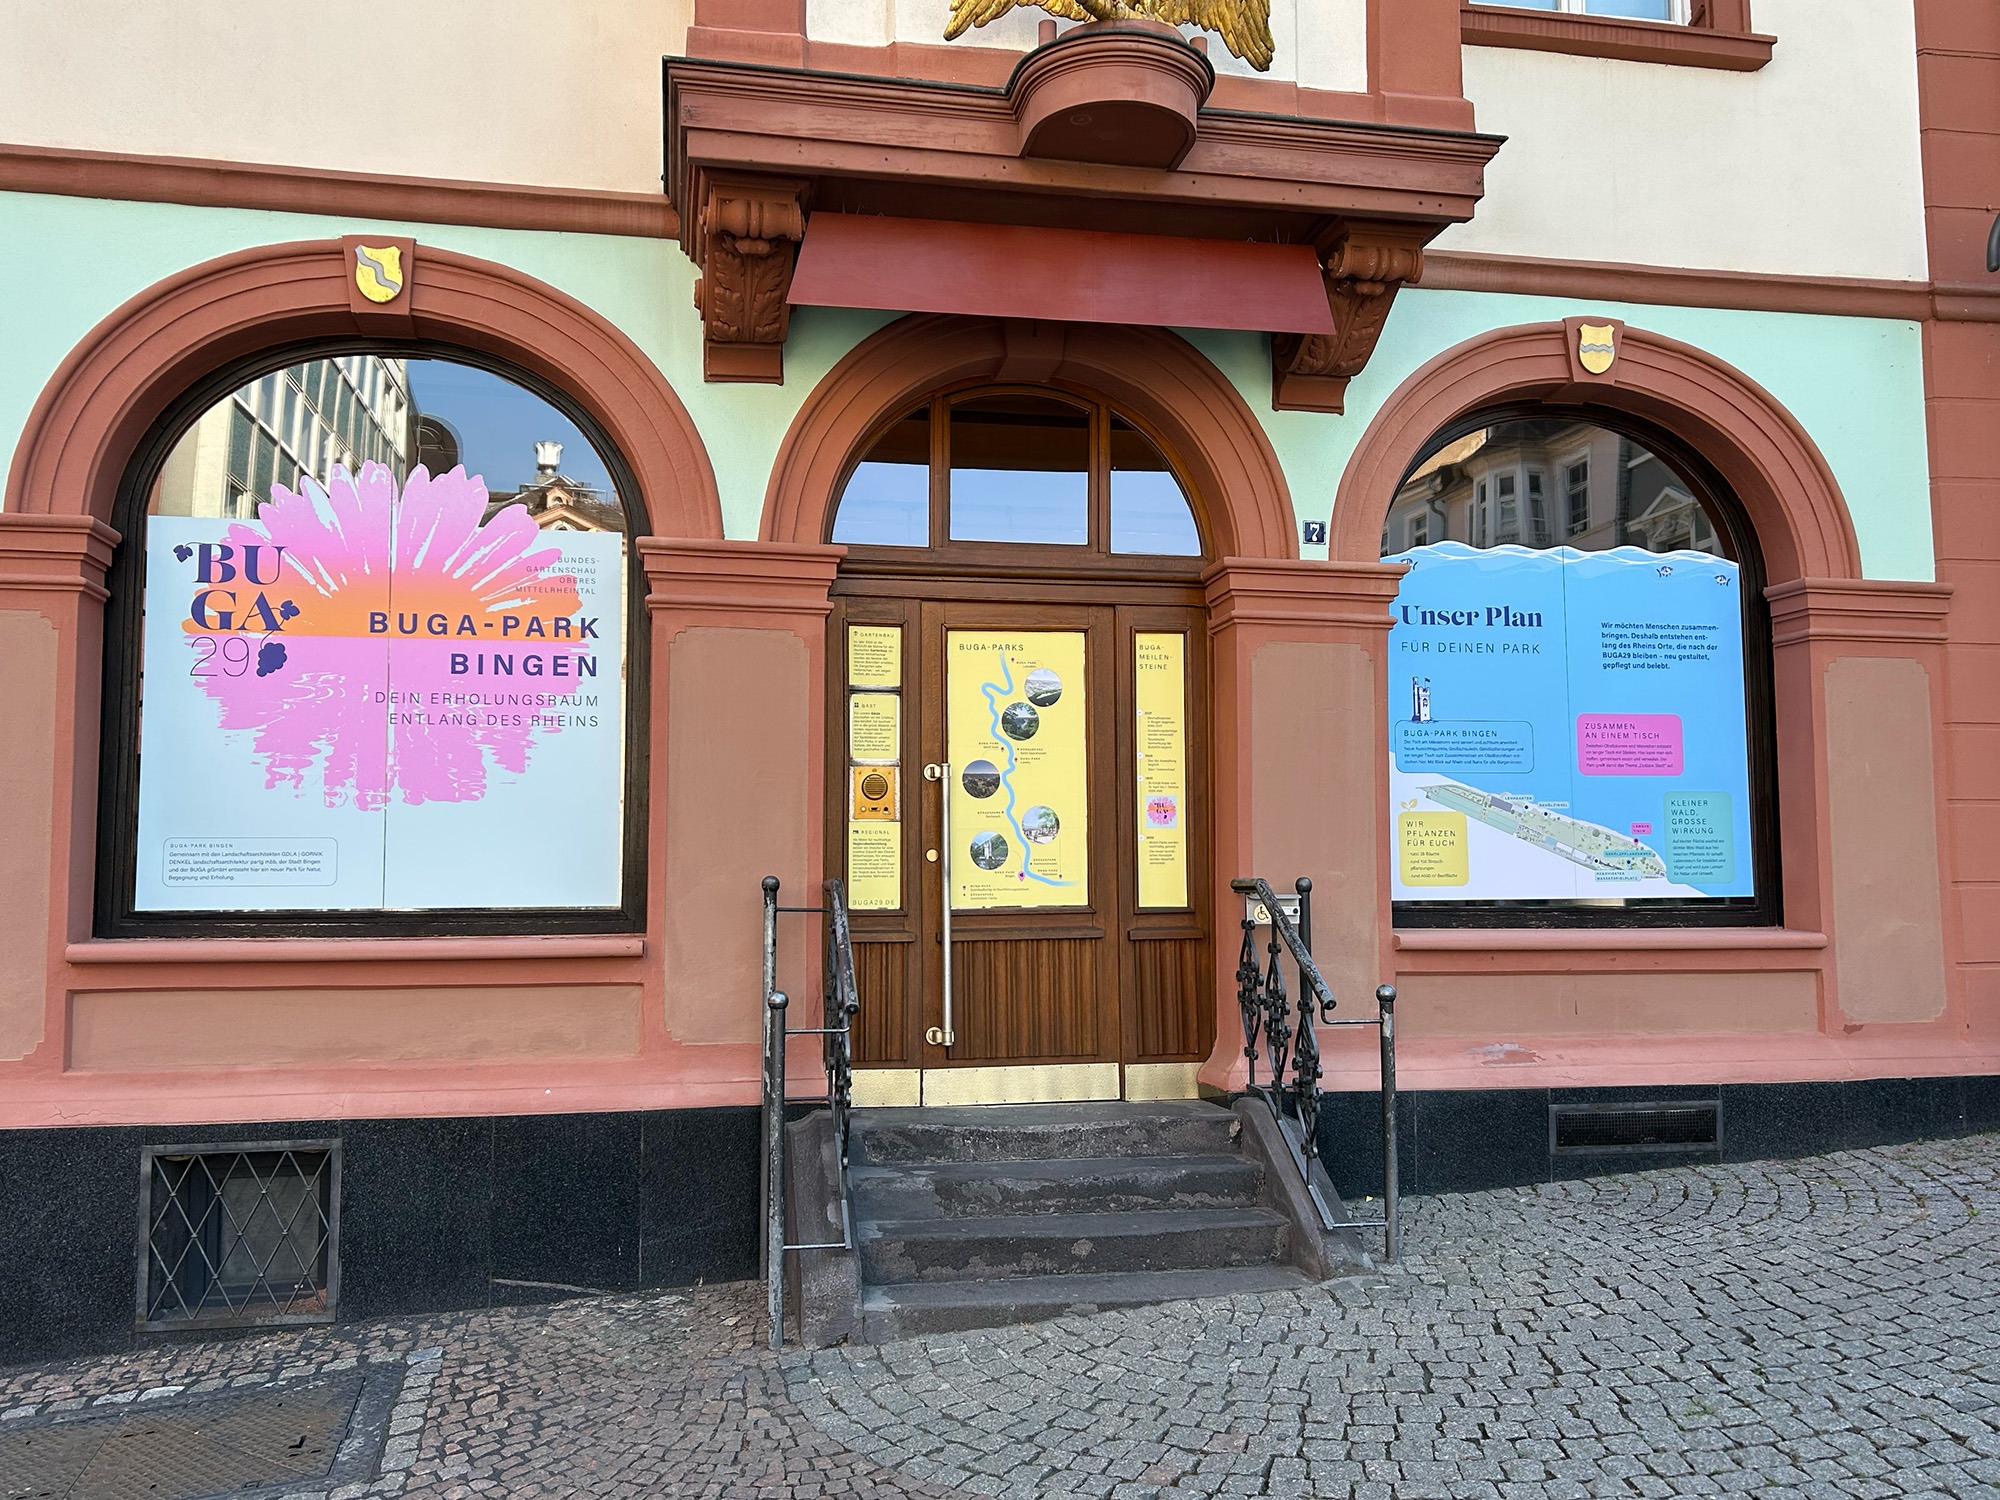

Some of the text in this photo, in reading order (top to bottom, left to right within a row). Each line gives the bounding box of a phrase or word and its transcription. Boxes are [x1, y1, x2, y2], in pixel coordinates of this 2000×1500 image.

[1310, 524, 1319, 541] 7
[191, 542, 286, 584] BU
[190, 590, 285, 631] GA
[1401, 605, 1542, 627] Unser Plan
[369, 612, 600, 638] BUGA-PARK
[190, 637, 249, 677] 29
[1402, 640, 1540, 654] FÜR DEINEN PARK
[451, 654, 598, 677] BINGEN
[376, 693, 598, 706] DEIN ERHOLUNGSRAUM
[389, 713, 599, 727] ENTLANG DES RHEINS
